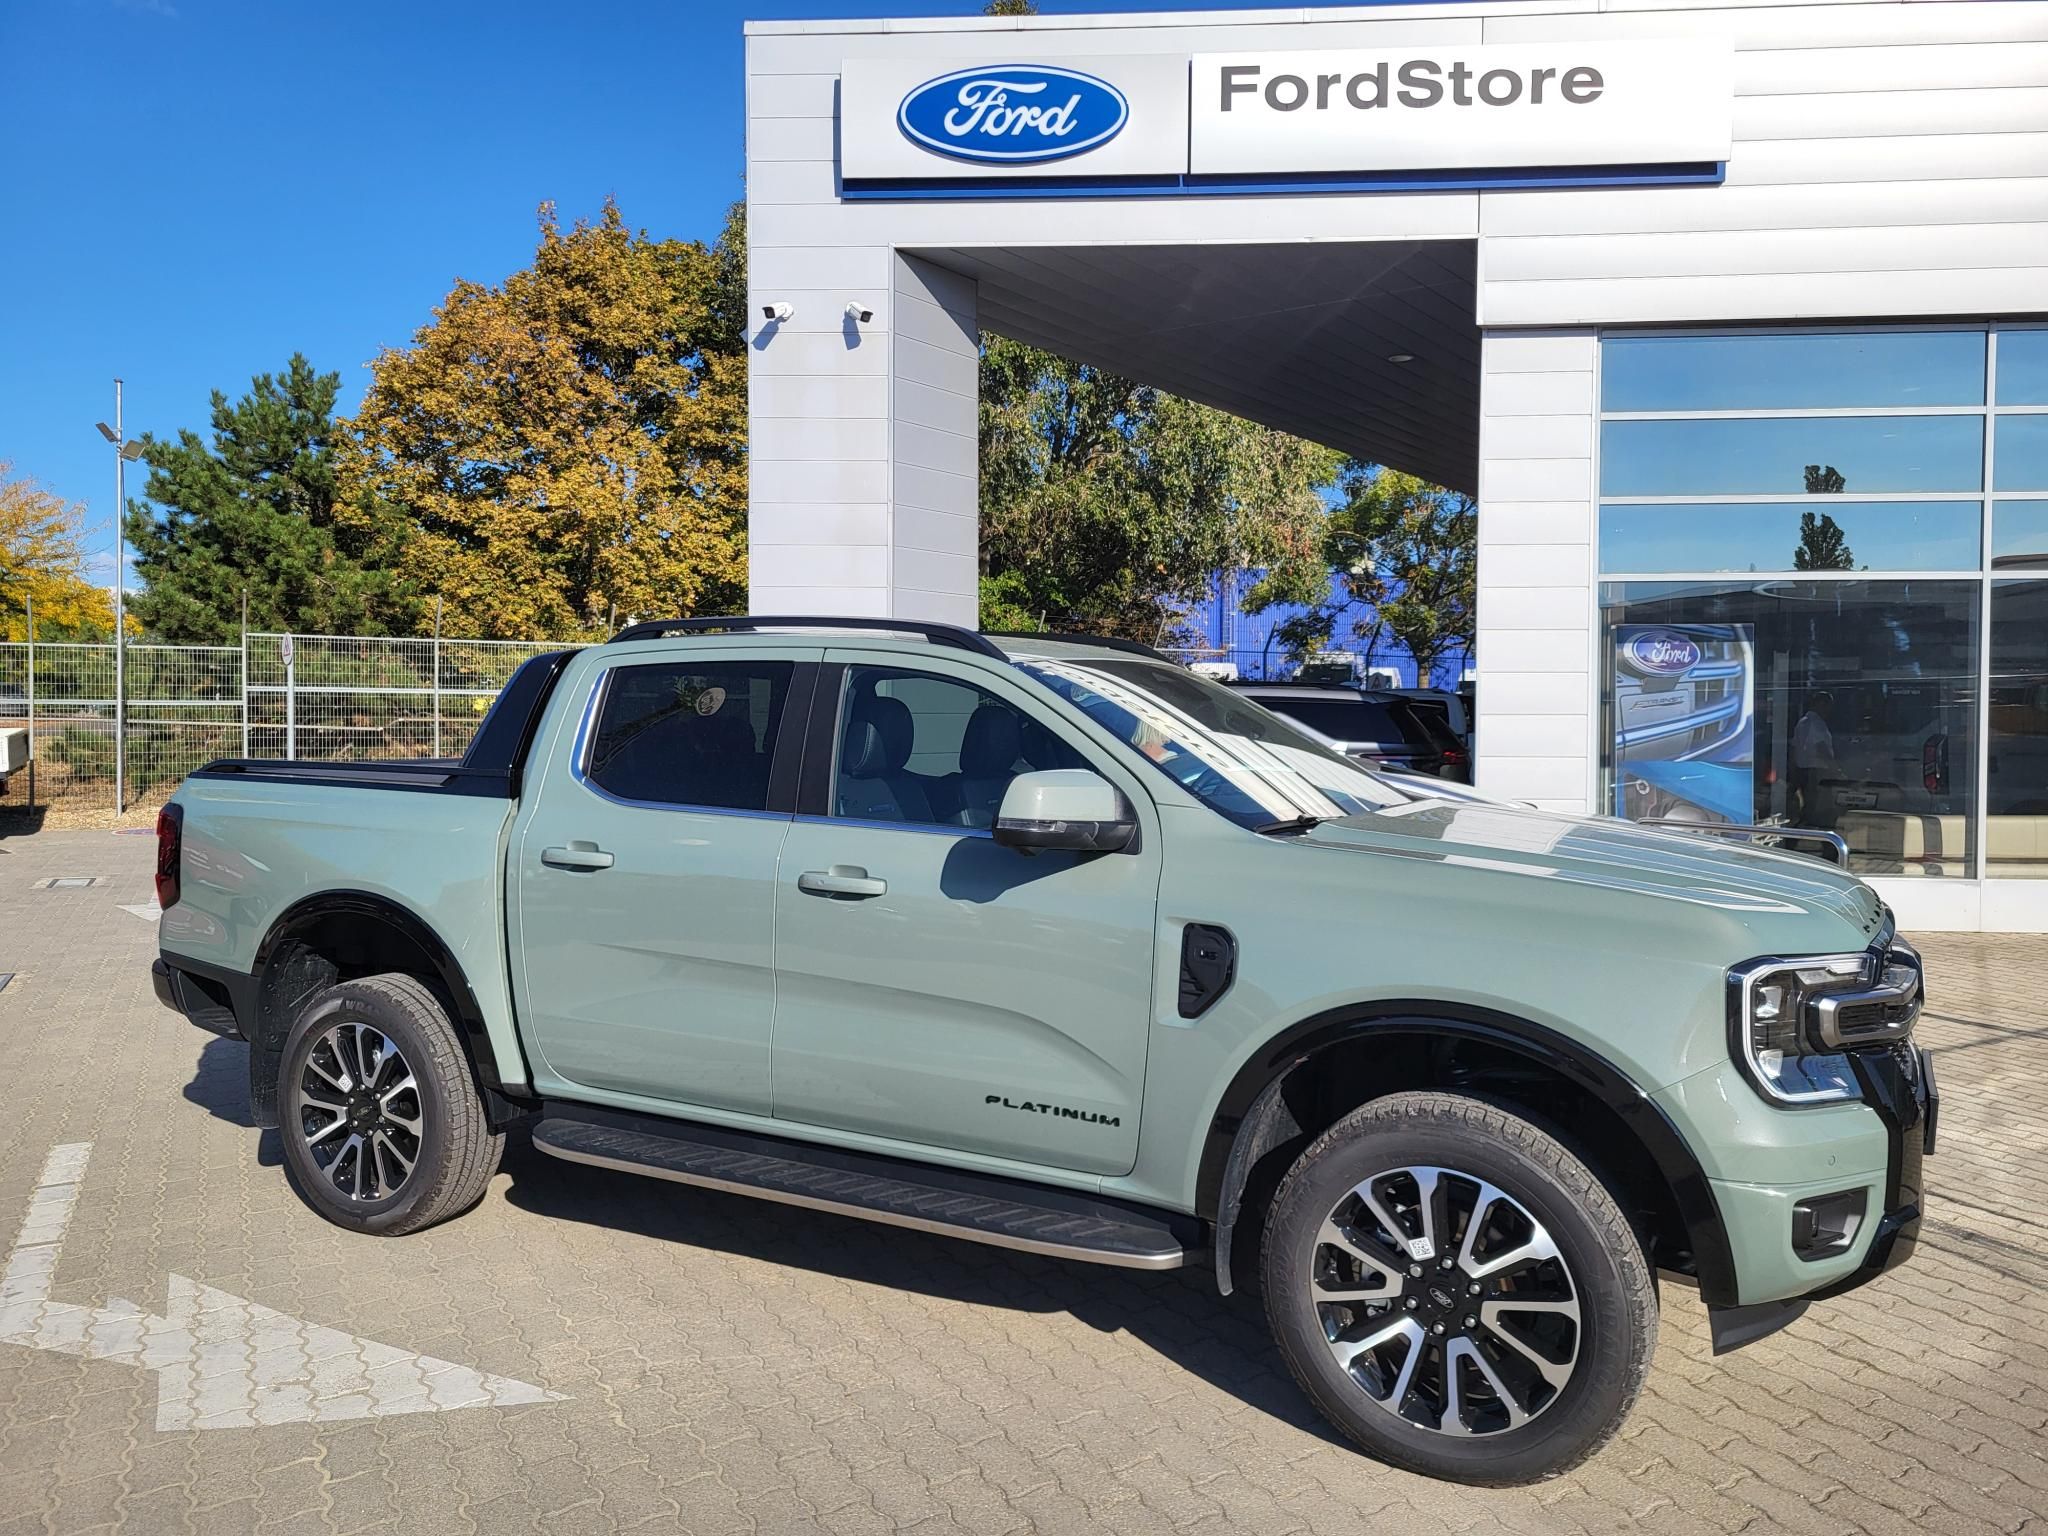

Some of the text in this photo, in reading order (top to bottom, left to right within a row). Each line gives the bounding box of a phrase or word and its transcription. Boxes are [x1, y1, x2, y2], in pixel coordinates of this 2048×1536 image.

[1220, 61, 1604, 112] FordStore
[944, 80, 1081, 137] Ford
[1651, 640, 1691, 663] Ford
[985, 1095, 1121, 1127] PLATINUM
